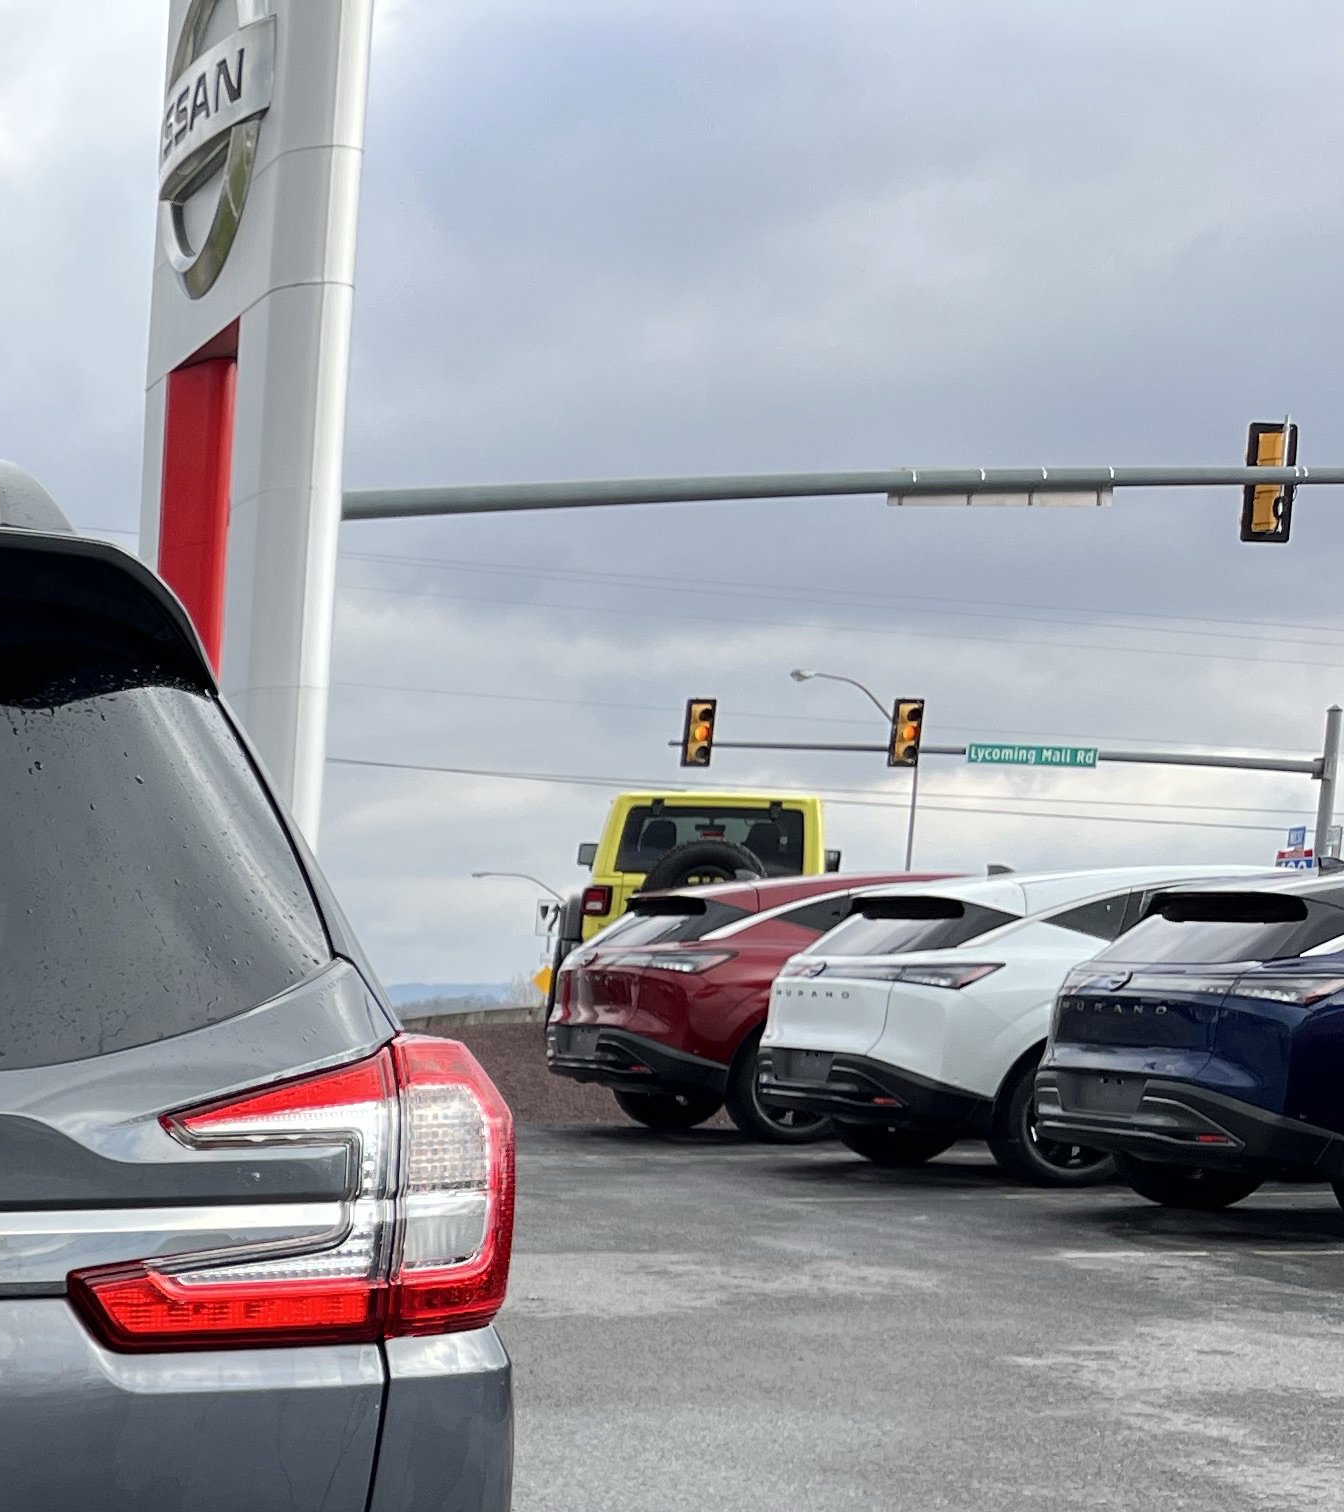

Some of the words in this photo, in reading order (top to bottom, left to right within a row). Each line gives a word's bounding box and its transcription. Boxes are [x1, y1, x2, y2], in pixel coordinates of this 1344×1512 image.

[163, 47, 245, 159] SSAN
[971, 746, 1036, 764] Lycoming
[1041, 750, 1071, 763] Mall
[1076, 752, 1095, 764] Rd
